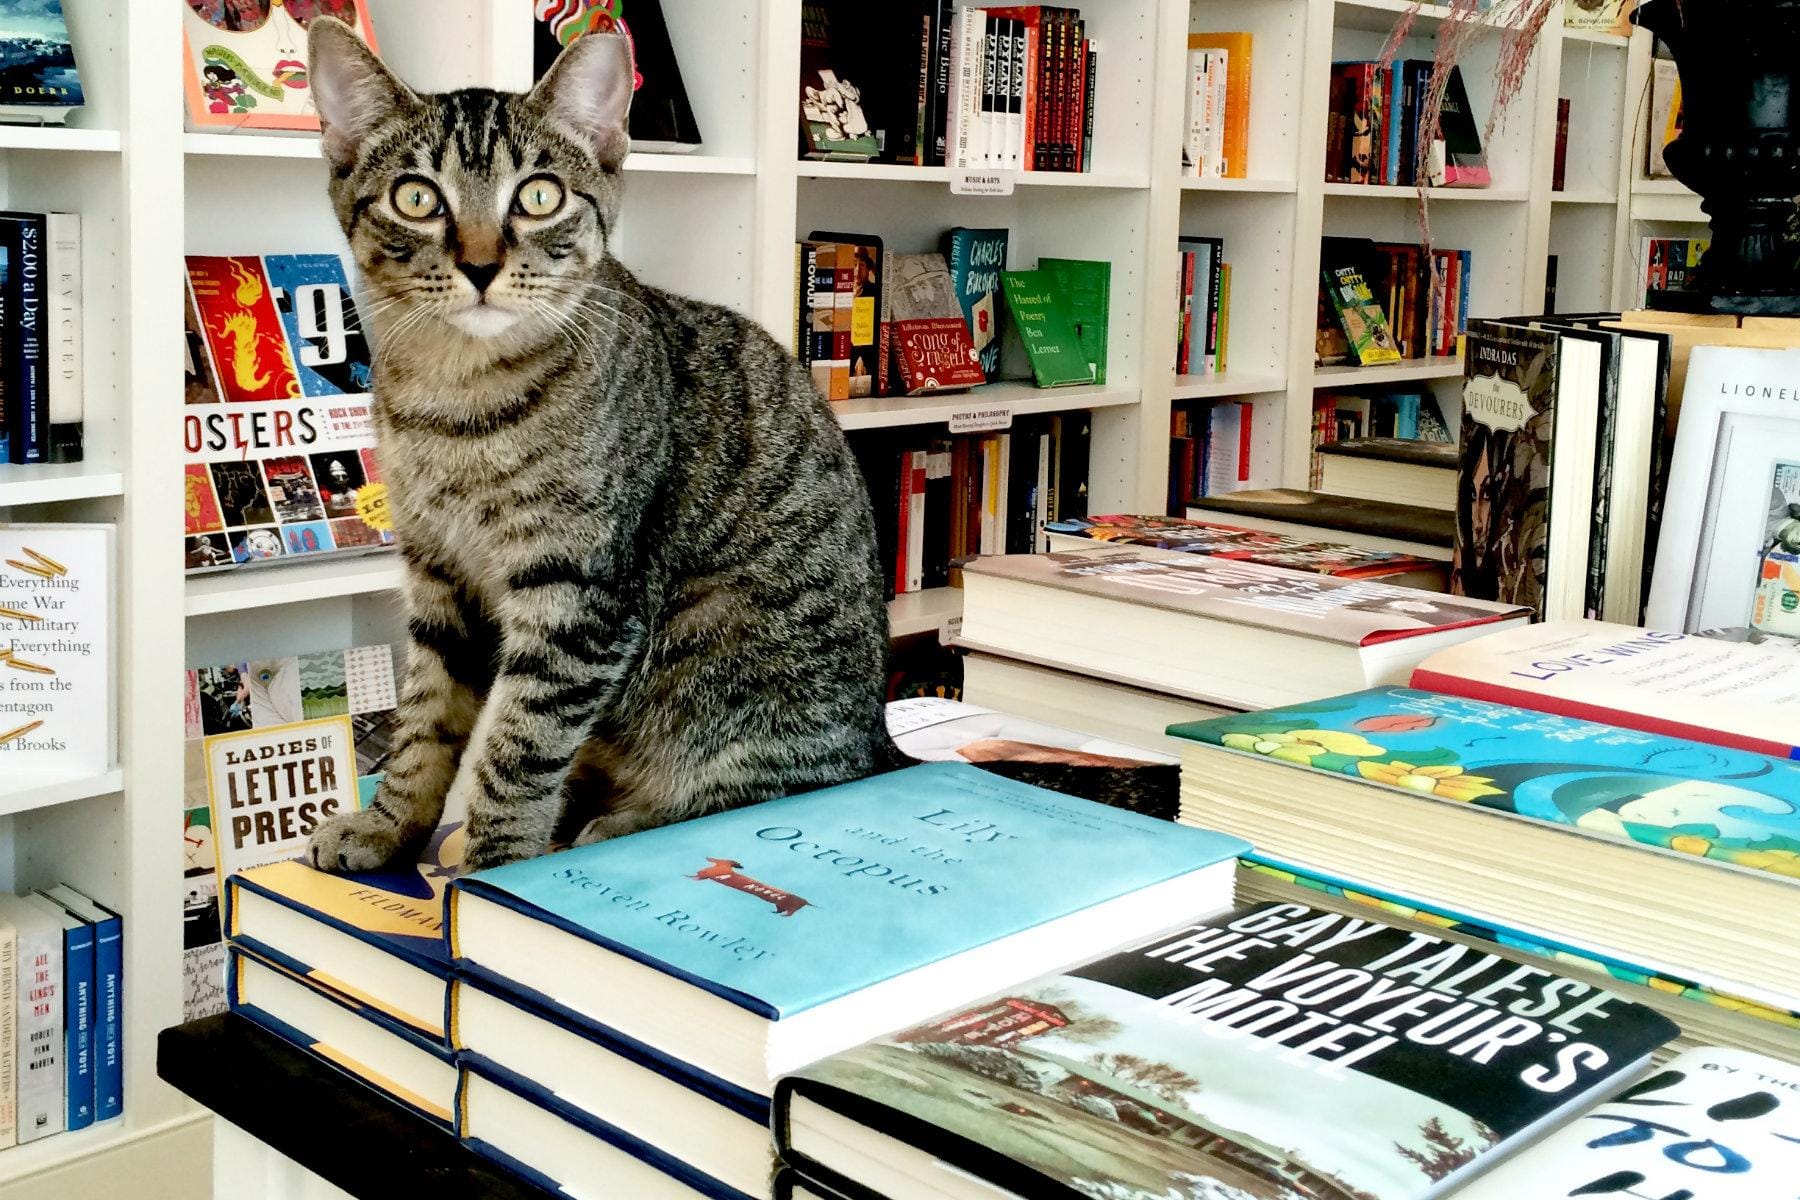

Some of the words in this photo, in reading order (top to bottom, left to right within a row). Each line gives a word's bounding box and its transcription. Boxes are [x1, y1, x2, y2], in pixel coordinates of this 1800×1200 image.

[942, 28, 950, 51] The
[937, 57, 949, 94] Banjo
[988, 34, 996, 95] DYLAN
[1001, 35, 1010, 95] DYLAN
[1015, 37, 1024, 96] DYLAN
[13, 86, 68, 95] DOERR
[22, 227, 38, 280] $2.00
[970, 240, 1005, 266] CHARLES
[23, 282, 35, 293] a
[806, 251, 816, 308] BEOWULF
[1008, 277, 1025, 288] The
[1014, 294, 1042, 304] Hatred
[1044, 293, 1052, 303] of
[20, 298, 39, 331] Day
[61, 273, 74, 380] EVICTED
[1020, 310, 1046, 324] Poetry
[1026, 326, 1043, 337] Ben
[1480, 346, 1500, 363] INDRA
[1502, 351, 1517, 366] DAS
[1720, 382, 1800, 401] LIONEL
[329, 408, 347, 419] ROCK
[1468, 391, 1524, 421] DEVOURERS
[0, 575, 80, 592] Everything
[34, 596, 65, 609] War
[18, 618, 80, 635] Military
[10, 638, 91, 655] Everything
[1510, 654, 1614, 681] LOVE
[1600, 631, 1685, 657] WINS
[10, 678, 44, 691] from
[50, 678, 72, 691] the
[16, 737, 66, 751] Brooks
[226, 738, 317, 765] LADIES
[321, 735, 333, 749] OF
[227, 755, 338, 809] LETTER
[913, 808, 1018, 843] Lily
[845, 827, 907, 846] and
[910, 845, 962, 864] the
[756, 826, 948, 895] Octopus
[744, 883, 787, 900] NOVEL
[553, 867, 650, 911] Steven
[655, 909, 776, 961] Rowley
[35, 954, 48, 967] ALL
[1227, 903, 1390, 956] GAY
[1360, 932, 1624, 1034] TALESE
[35, 969, 49, 982] THE
[29, 985, 55, 1001] KING'S
[107, 973, 116, 1022] ANYTHING
[34, 1005, 50, 1017] MEN
[78, 981, 88, 1031] ANYTHING
[1140, 924, 1277, 973] THE
[1243, 953, 1610, 1093] VOYEUR'S
[30, 1027, 54, 1042] ROBERT
[1157, 977, 1400, 1080] MOTEL
[34, 1043, 50, 1055] PENN
[107, 1040, 117, 1066] VOTE
[30, 1056, 55, 1070] WARREN
[78, 1050, 88, 1075] VOTE
[1701, 1063, 1741, 1074] BY
[1755, 1072, 1800, 1092] THE
